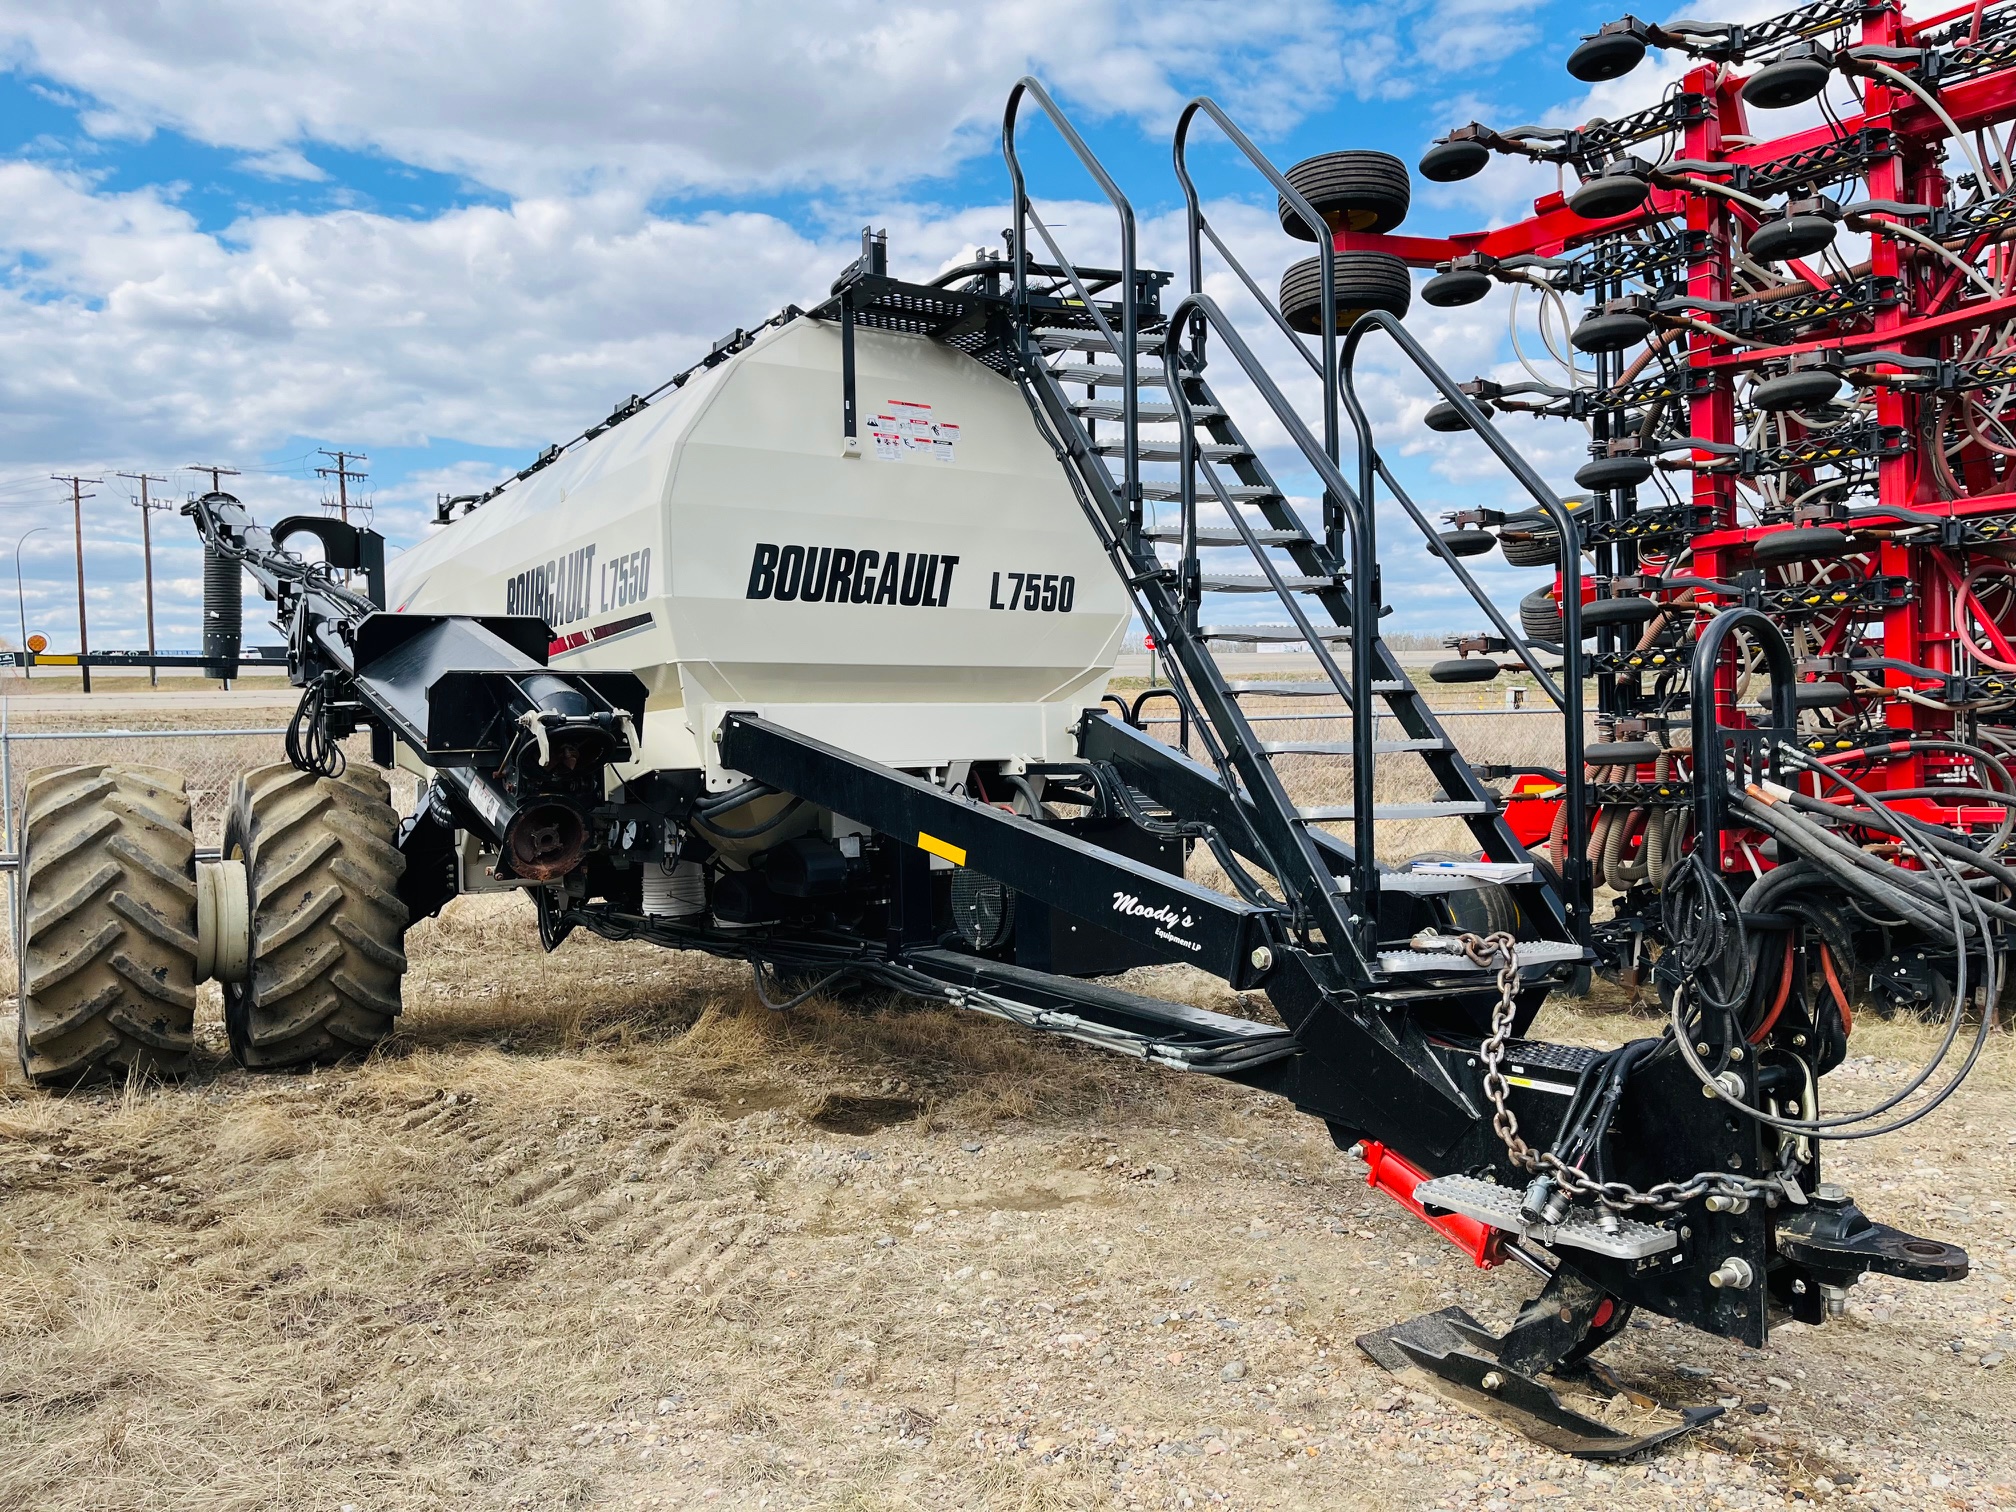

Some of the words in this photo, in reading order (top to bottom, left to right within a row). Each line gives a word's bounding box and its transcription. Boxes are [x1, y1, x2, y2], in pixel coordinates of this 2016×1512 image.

[507, 543, 596, 628] BOURGAULT
[601, 548, 651, 613] L7550
[746, 543, 960, 607] BOURGAULT
[990, 572, 1075, 613] L7550
[1113, 892, 1195, 929] Moody's
[1155, 927, 1192, 949] Equipment
[1191, 942, 1202, 951] LP
